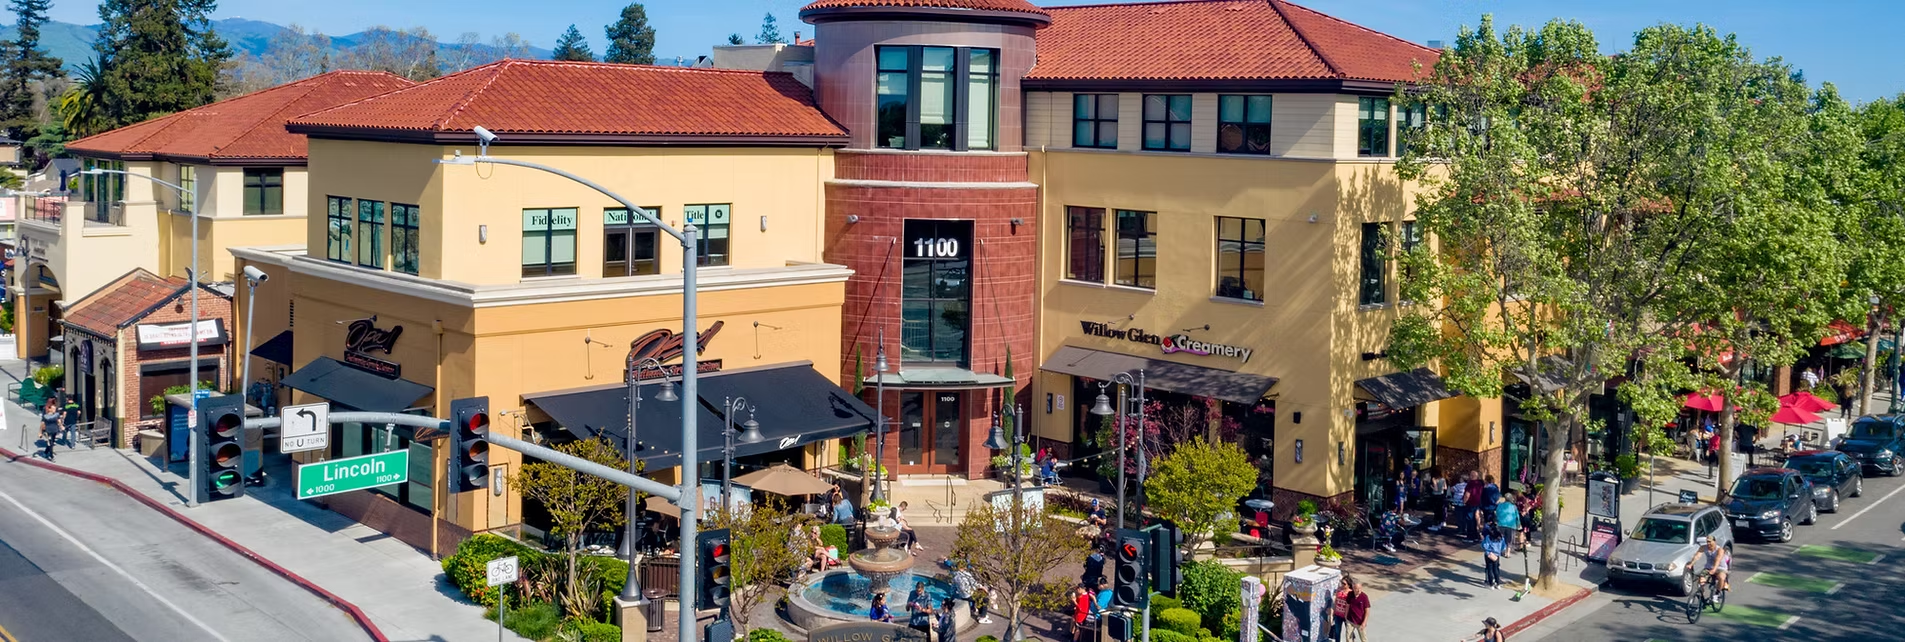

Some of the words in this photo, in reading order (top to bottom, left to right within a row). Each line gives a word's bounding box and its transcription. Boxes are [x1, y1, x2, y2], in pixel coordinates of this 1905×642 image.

[531, 214, 573, 226] Fidelity
[685, 210, 705, 221] Title
[913, 237, 959, 257] 1100
[1080, 320, 1127, 340] Willow
[1127, 328, 1161, 345] Glen
[1177, 335, 1252, 363] Creamery
[296, 439, 304, 447] U
[307, 437, 325, 445] TURN
[323, 458, 386, 482] Lincoln
[376, 474, 393, 484] 1100
[315, 483, 335, 494] 1000
